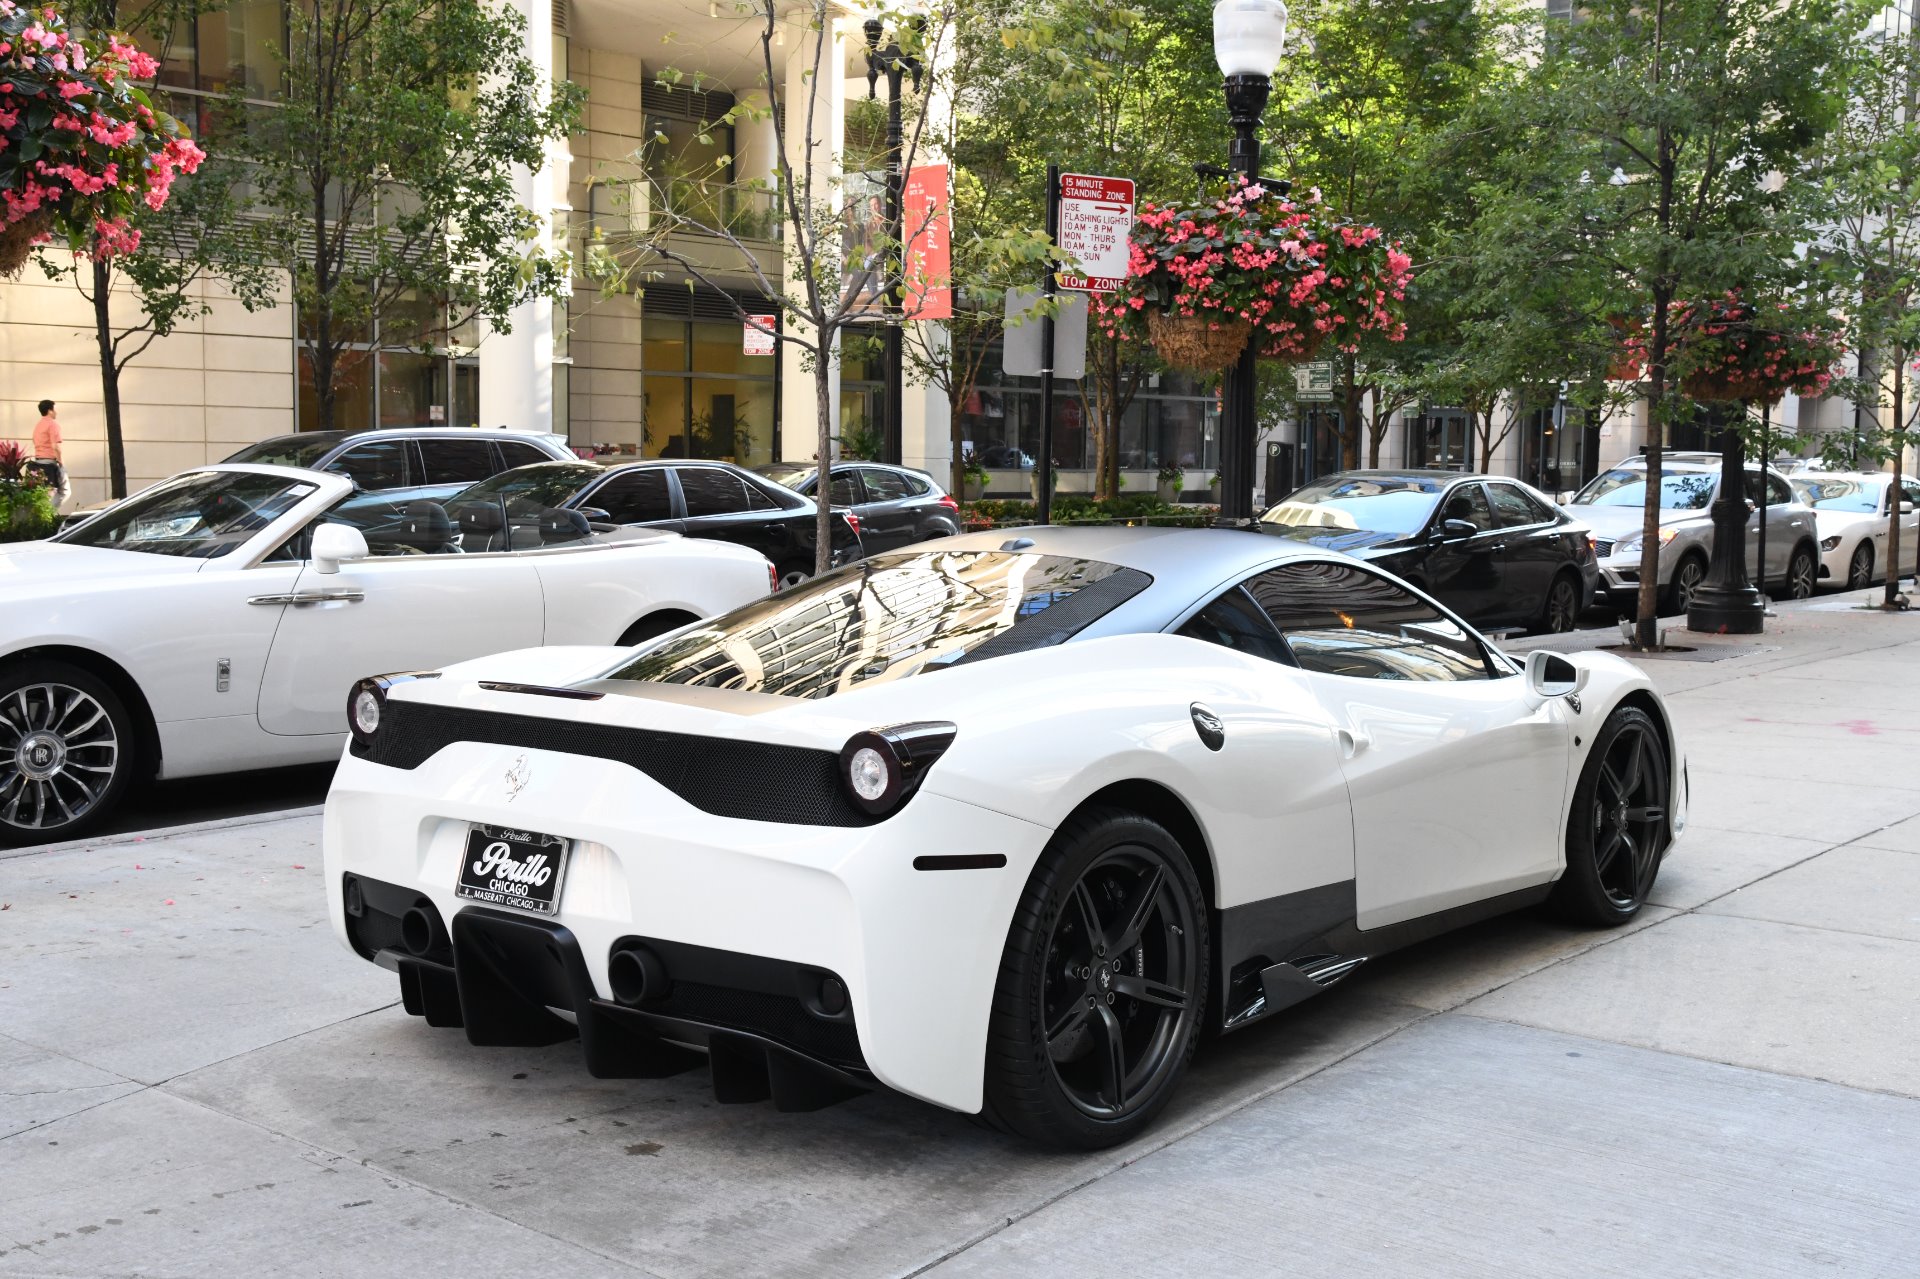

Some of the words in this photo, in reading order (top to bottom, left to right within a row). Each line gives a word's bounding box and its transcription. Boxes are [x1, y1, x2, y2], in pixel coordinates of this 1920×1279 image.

[1065, 178, 1073, 186] 15
[1076, 178, 1104, 189] MINUTE
[1065, 187, 1102, 198] STANDING
[1106, 191, 1126, 201] ZONE
[1065, 203, 1080, 212] USE
[926, 195, 938, 249] Foded
[1064, 212, 1102, 224] FLASHING
[1103, 216, 1129, 226] LIGHTS
[1064, 222, 1073, 231] 10
[1073, 223, 1086, 231] AM
[1094, 224, 1099, 232] 8
[1101, 225, 1113, 234] PM
[1064, 231, 1081, 240] MON
[1090, 233, 1116, 243] THURS
[1064, 241, 1072, 249] 10
[1072, 241, 1085, 250] AM
[1093, 244, 1098, 252] 6
[1100, 244, 1111, 252] PM
[1084, 252, 1100, 261] SUN
[1063, 275, 1088, 288] TOW
[473, 842, 551, 887] Perillo
[489, 878, 528, 896] CHICAGO
[473, 890, 505, 904] MASERATI
[506, 896, 534, 910] CHICAGO
